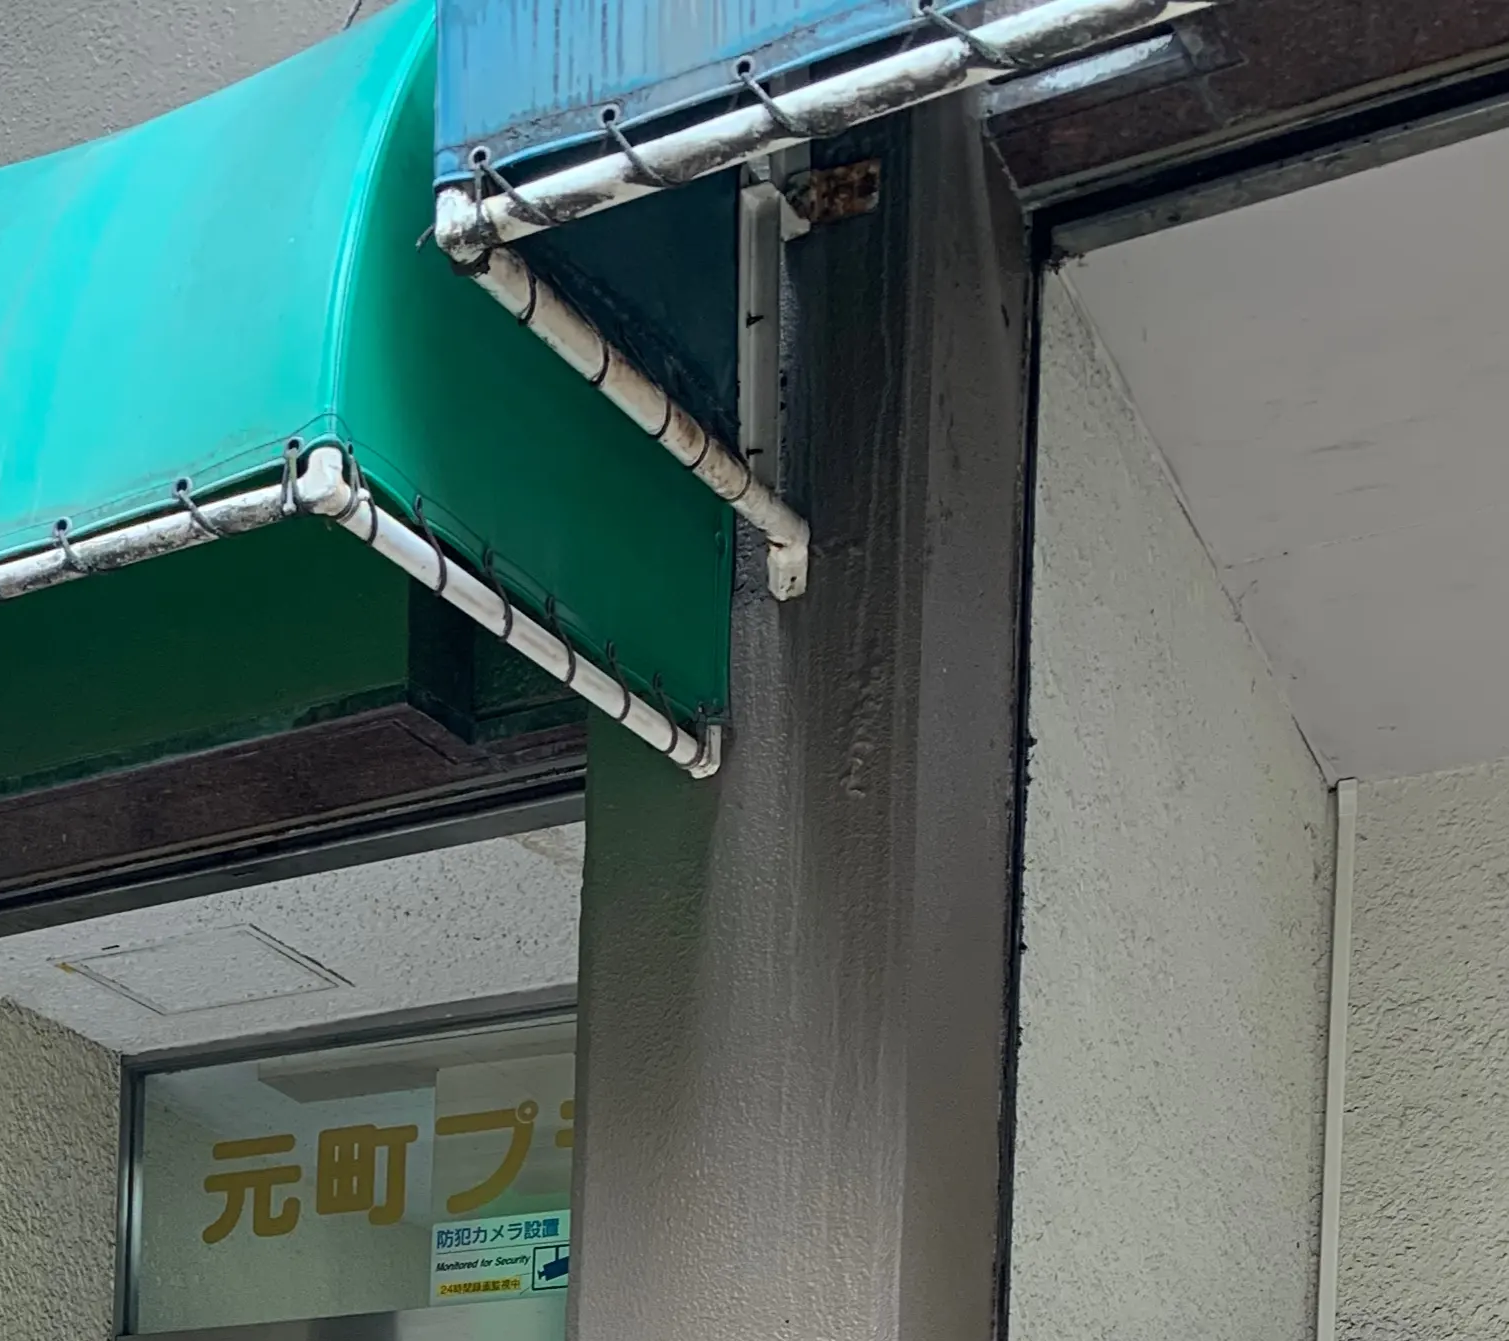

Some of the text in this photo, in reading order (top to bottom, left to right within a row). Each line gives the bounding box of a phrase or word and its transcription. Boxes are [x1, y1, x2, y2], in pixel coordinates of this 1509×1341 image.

[202, 1100, 574, 1244] 元町プ
[436, 1217, 560, 1250] 防犯カメラ設置
[434, 1254, 532, 1273] Monitored for Security
